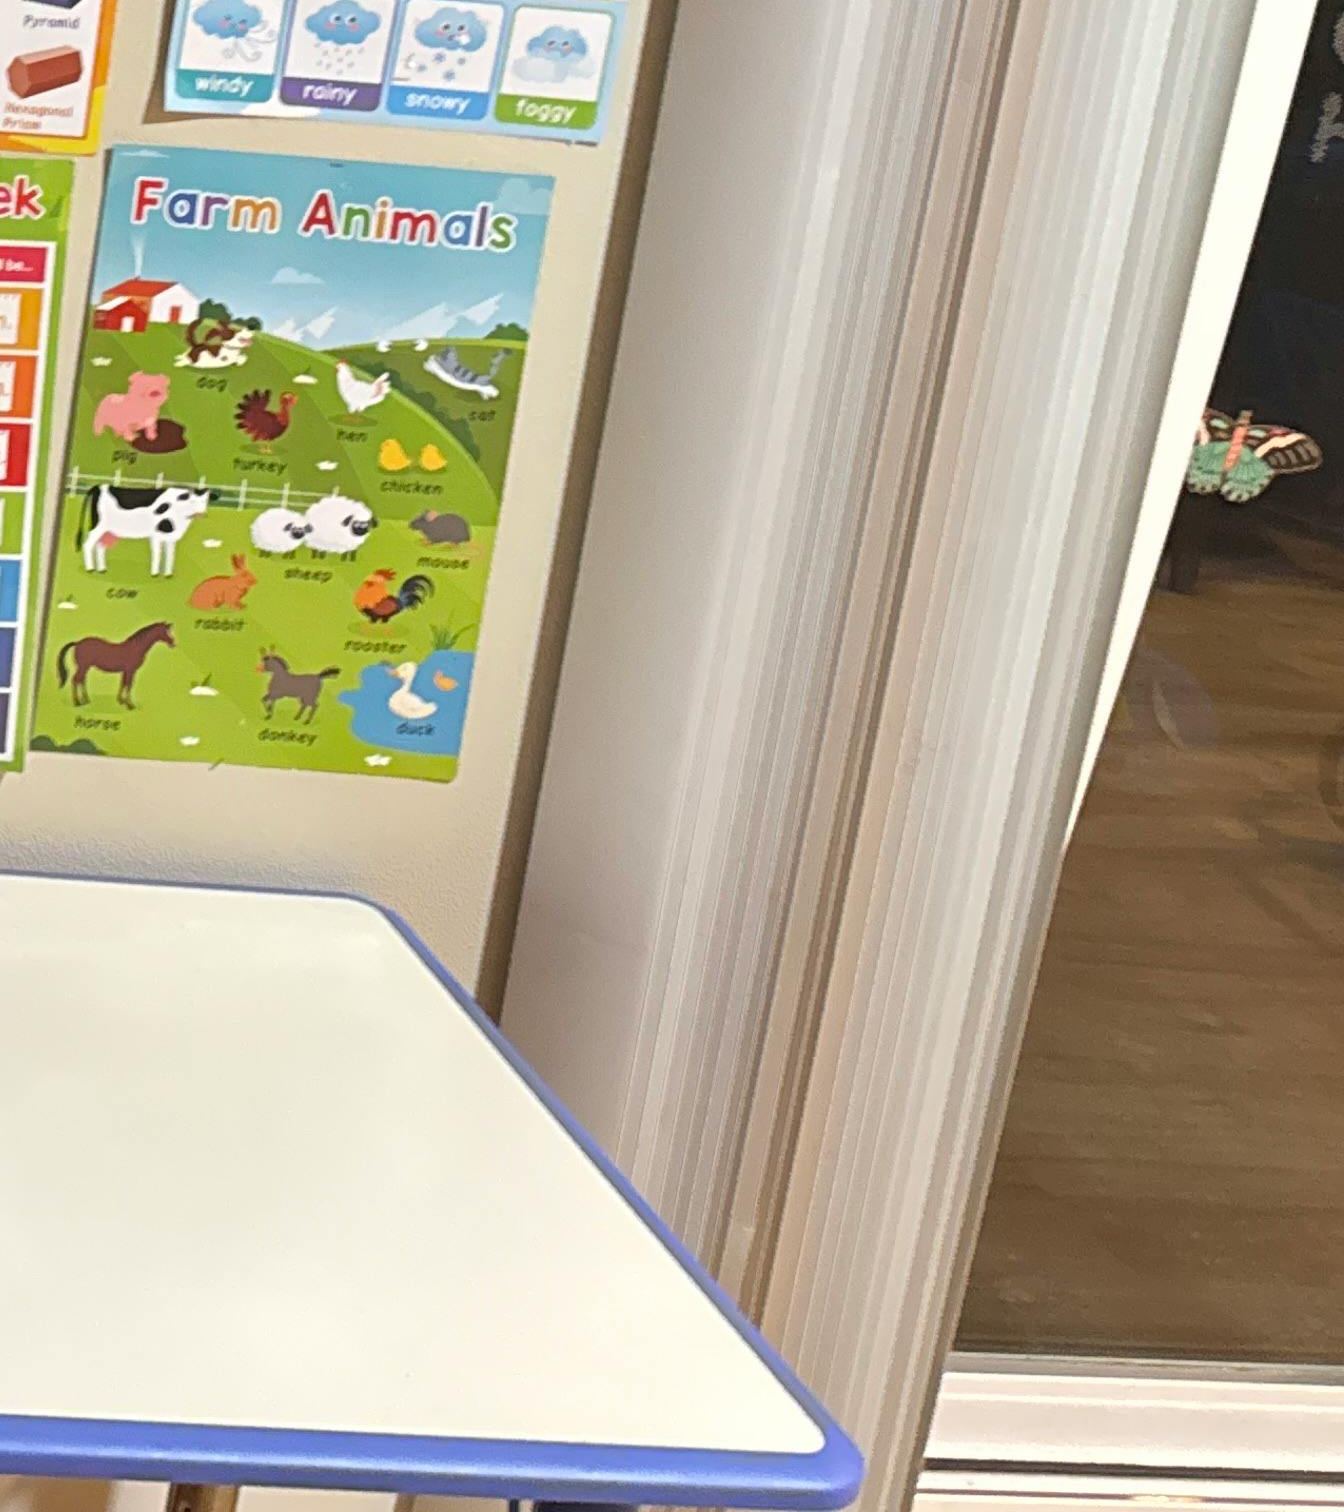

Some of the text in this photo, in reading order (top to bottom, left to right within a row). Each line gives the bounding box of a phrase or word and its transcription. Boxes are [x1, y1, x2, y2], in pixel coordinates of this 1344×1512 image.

[22, 14, 81, 29] Pyramid
[194, 74, 256, 97] windy
[302, 83, 358, 105] rainy
[404, 91, 472, 113] snowy
[515, 100, 577, 125] foggy
[130, 175, 518, 253] Farm Animals
[336, 428, 370, 442] hen
[233, 457, 288, 476] turkey
[380, 479, 443, 496] chicken
[415, 555, 471, 570] mouse
[283, 566, 334, 584] sheep
[105, 586, 140, 600] cow
[194, 617, 246, 632] rabbit
[343, 638, 408, 655] rooster
[73, 715, 123, 732] horse
[257, 728, 318, 748] donkey
